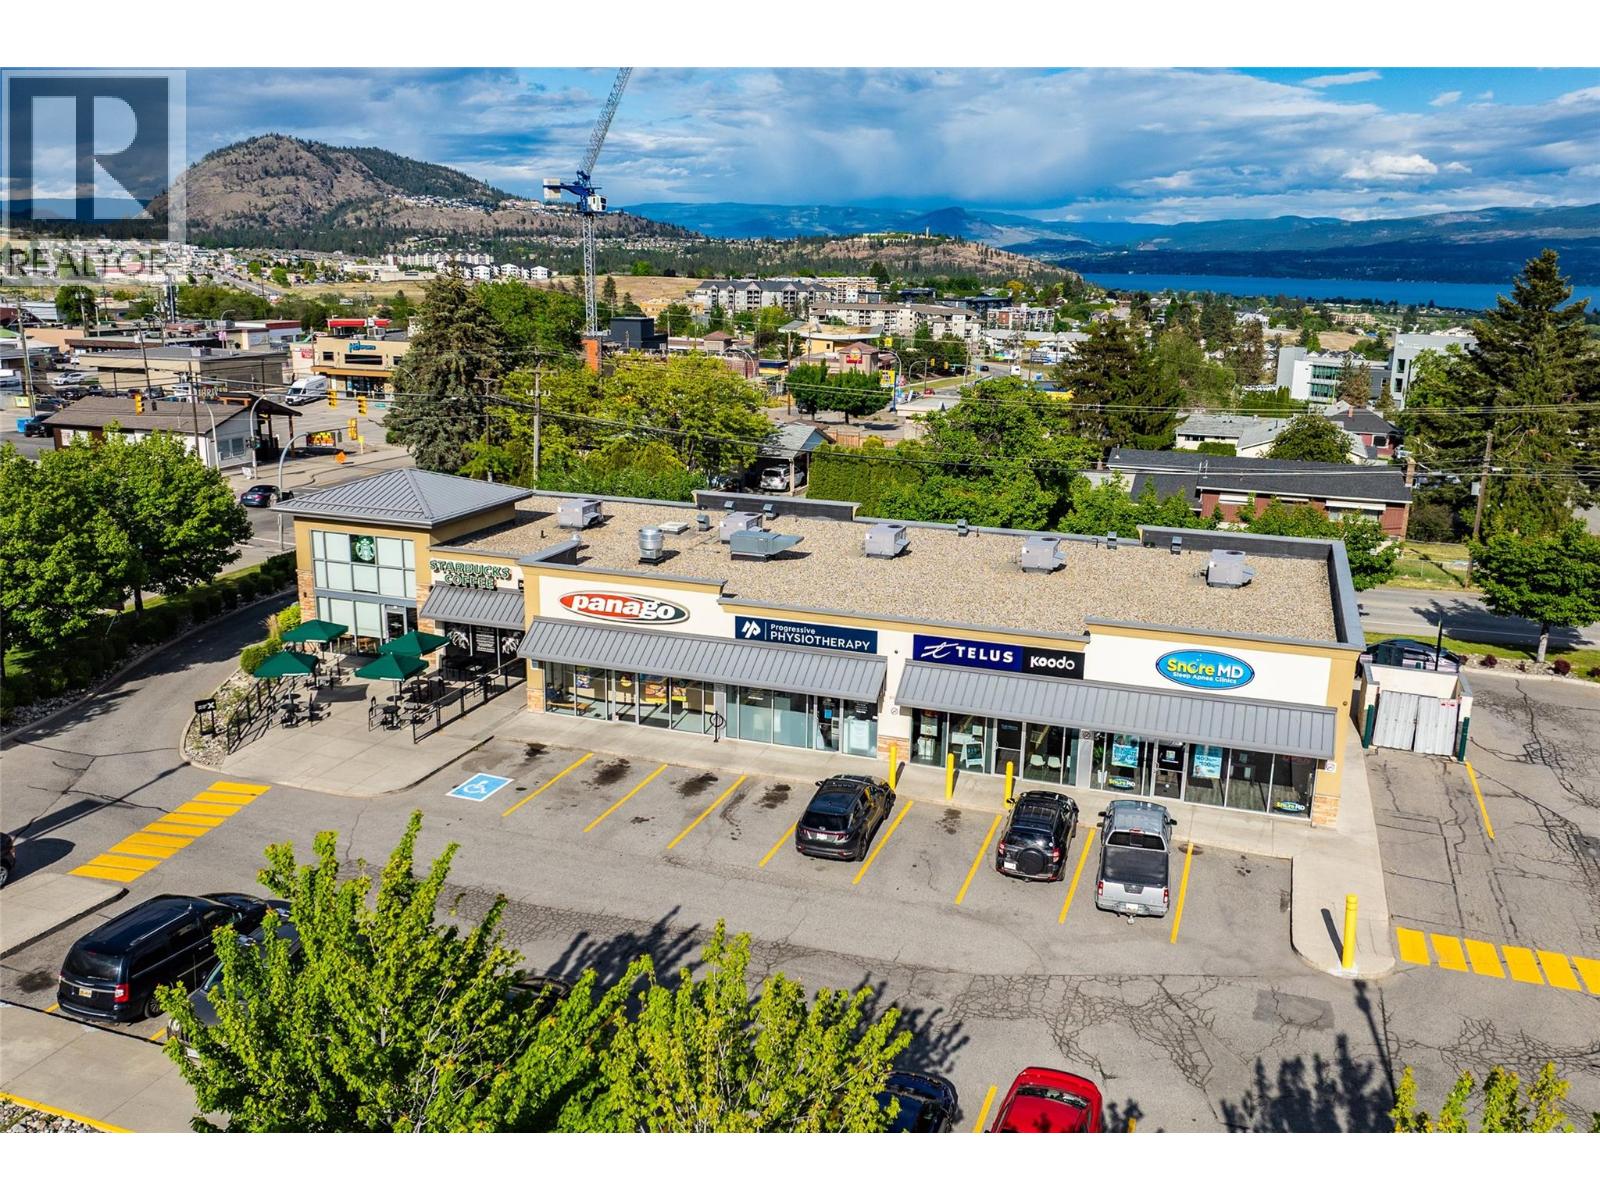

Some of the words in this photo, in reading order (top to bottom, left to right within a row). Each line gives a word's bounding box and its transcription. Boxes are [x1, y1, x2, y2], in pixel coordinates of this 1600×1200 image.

[430, 560, 510, 578] STARBUCKS
[445, 573, 494, 589] COFFEE
[571, 595, 675, 620] panago
[770, 623, 816, 635] Progressive
[770, 630, 871, 651] PHYSIOTHERAPY
[955, 645, 1014, 664] TELUS
[1173, 671, 1191, 679] Sleep
[1215, 676, 1237, 684] Clinics
[1217, 664, 1244, 679] MD
